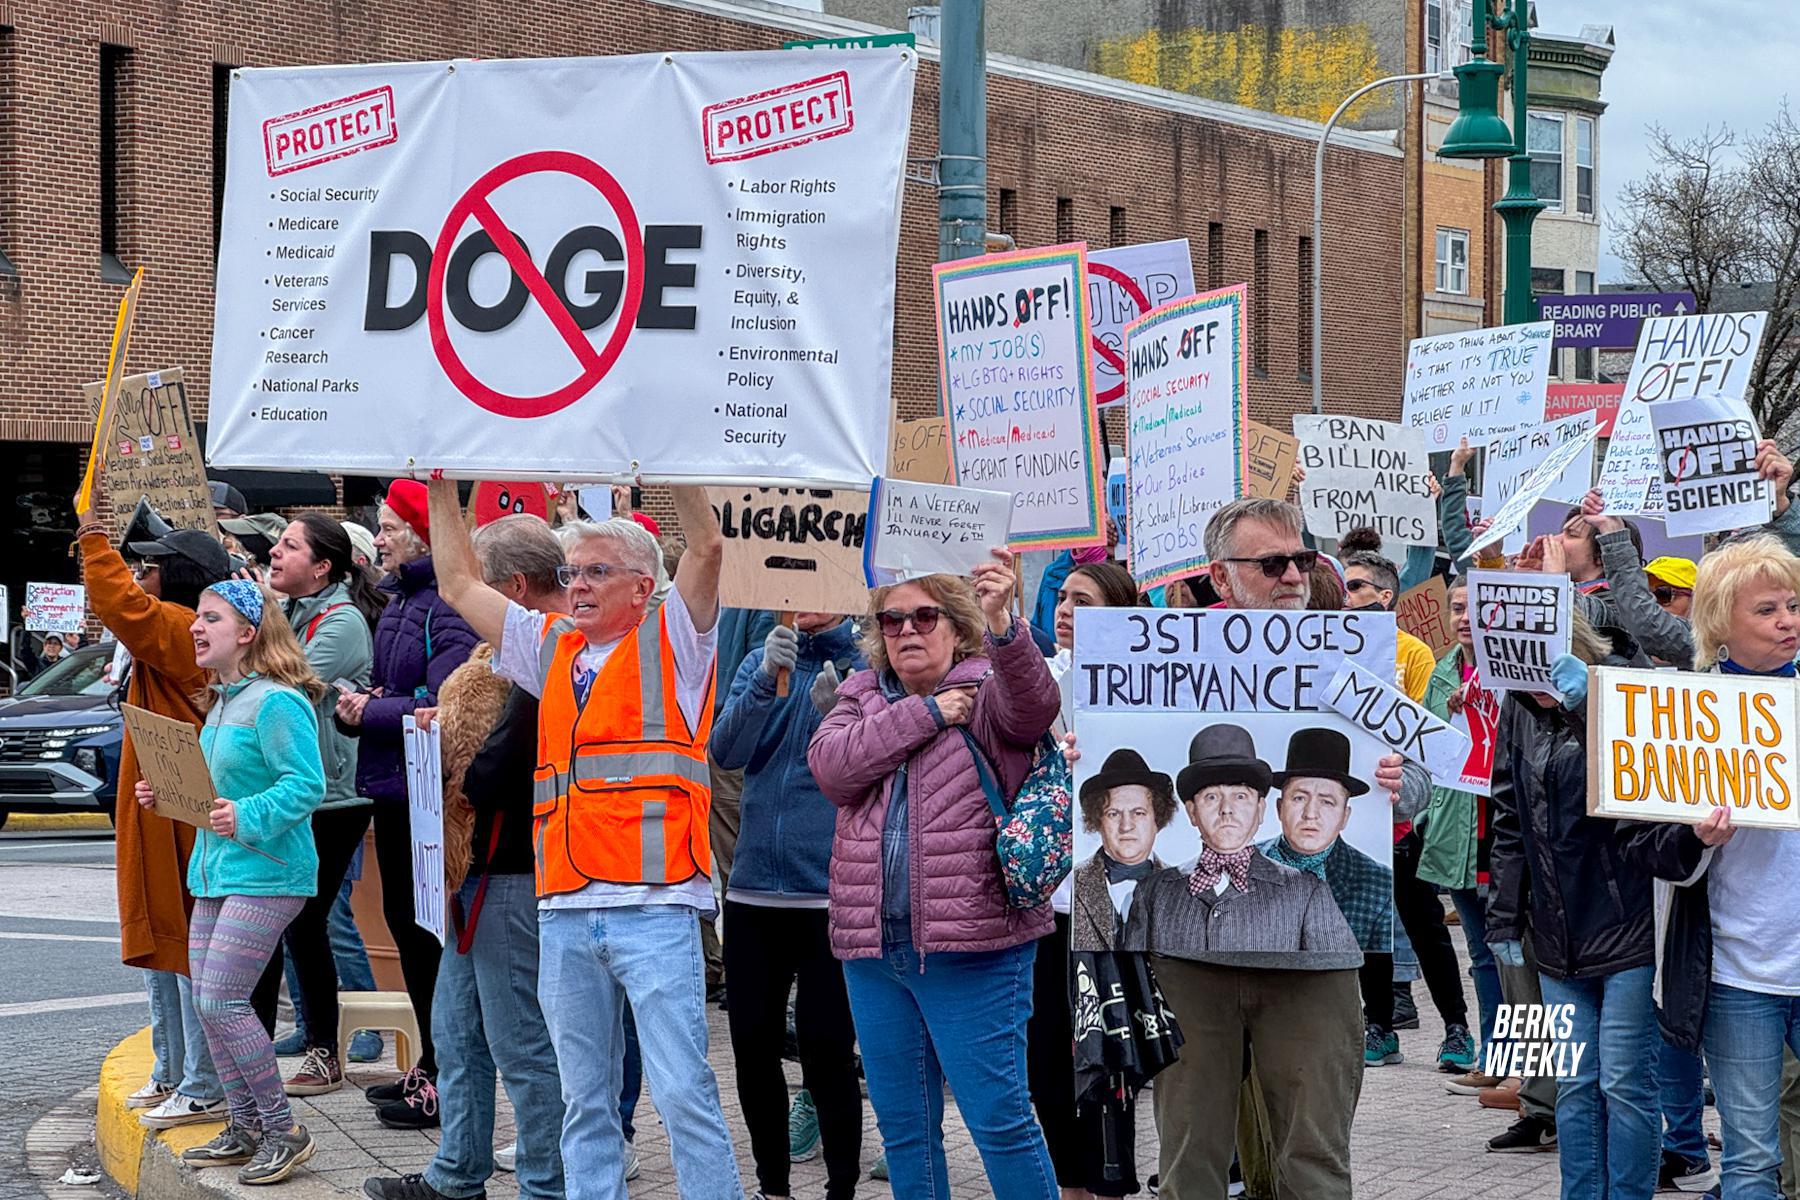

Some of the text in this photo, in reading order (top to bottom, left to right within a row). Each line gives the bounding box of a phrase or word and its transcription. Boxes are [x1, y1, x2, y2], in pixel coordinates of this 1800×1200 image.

[717, 90, 839, 148] PROTECT
[276, 104, 384, 160] PROTECT
[280, 187, 379, 203] Social Security
[740, 179, 836, 197] Labor Rights
[278, 217, 339, 231] Medicare
[736, 208, 826, 227] Immigration
[276, 245, 335, 260] Medicaid
[736, 233, 787, 250] Rights
[274, 274, 329, 288] Veterans
[364, 225, 703, 332] DOGE
[736, 264, 806, 283] Diversity,
[272, 298, 326, 312] Services
[733, 290, 799, 307] Equity, &
[948, 277, 1070, 334] HANDS OFF!
[1207, 289, 1246, 310] COURTS
[731, 316, 796, 330] Inclusion
[1542, 303, 1662, 321] READING PUBLIC
[270, 327, 314, 340] Cancer
[1232, 304, 1243, 366] MEDICAL
[1555, 323, 1604, 339] BRARY
[1642, 313, 1757, 364] HANDS
[729, 346, 838, 364] Environmental
[989, 331, 1046, 360] JOB(S)
[1132, 336, 1169, 381] HANDS
[1176, 321, 1219, 359] OFF
[1414, 341, 1432, 357] THE
[1433, 340, 1455, 353] GOOD
[1459, 337, 1485, 349] THING
[1489, 331, 1515, 345] ABOUT
[265, 351, 328, 364] Research
[1412, 345, 1538, 380] IS THAT IT'S TRUE
[262, 379, 359, 392] National Parks
[728, 372, 774, 390] Policy
[962, 365, 1064, 390] LGBTQ+ RIGHTS
[1410, 370, 1534, 405] WHETHER OR NOT YOU
[1633, 358, 1734, 402] OFF!
[1136, 372, 1210, 408] SOCIAL SECURITY
[261, 407, 328, 421] Education
[725, 403, 787, 418] National
[969, 386, 1076, 422] SOCIAL SECURITY
[1411, 395, 1501, 428] BELIEVE IN IT!
[1620, 409, 1645, 425] Our
[724, 429, 787, 447] Security
[1185, 427, 1228, 449] Services
[1329, 419, 1386, 442] BAN
[1488, 419, 1591, 464] FIGHT FOR THOSE
[1612, 430, 1651, 442] Medicare
[1663, 422, 1752, 449] HANDS
[1303, 445, 1413, 471] BILLION-
[1609, 445, 1634, 457] Public
[1667, 440, 1757, 480] OFF!
[971, 450, 1080, 482] GRANT FUNDING
[1143, 473, 1162, 496] Our
[1168, 464, 1206, 491] Bodies
[1374, 471, 1432, 499] AIRES
[1600, 475, 1649, 486] Free Speech
[910, 496, 918, 509] A
[925, 493, 981, 515] VETERAN
[1014, 487, 1079, 508] GRANTS
[1313, 488, 1378, 514] FROM
[1666, 479, 1766, 513] SCIENCE
[885, 523, 952, 544] JANUARY
[911, 514, 942, 526] NEVER
[949, 517, 985, 531] FORGET
[1152, 523, 1198, 558] JOBS
[28, 585, 76, 596] Destruction
[1480, 585, 1557, 604] HANDS
[28, 602, 75, 612] Government
[1480, 603, 1556, 632] OFF!
[1483, 635, 1552, 668] CIVIL
[1332, 671, 1446, 763] MUSK
[1616, 683, 1782, 747] THIS IS
[1458, 776, 1489, 787] READING
[1612, 739, 1791, 811] BANANAS
